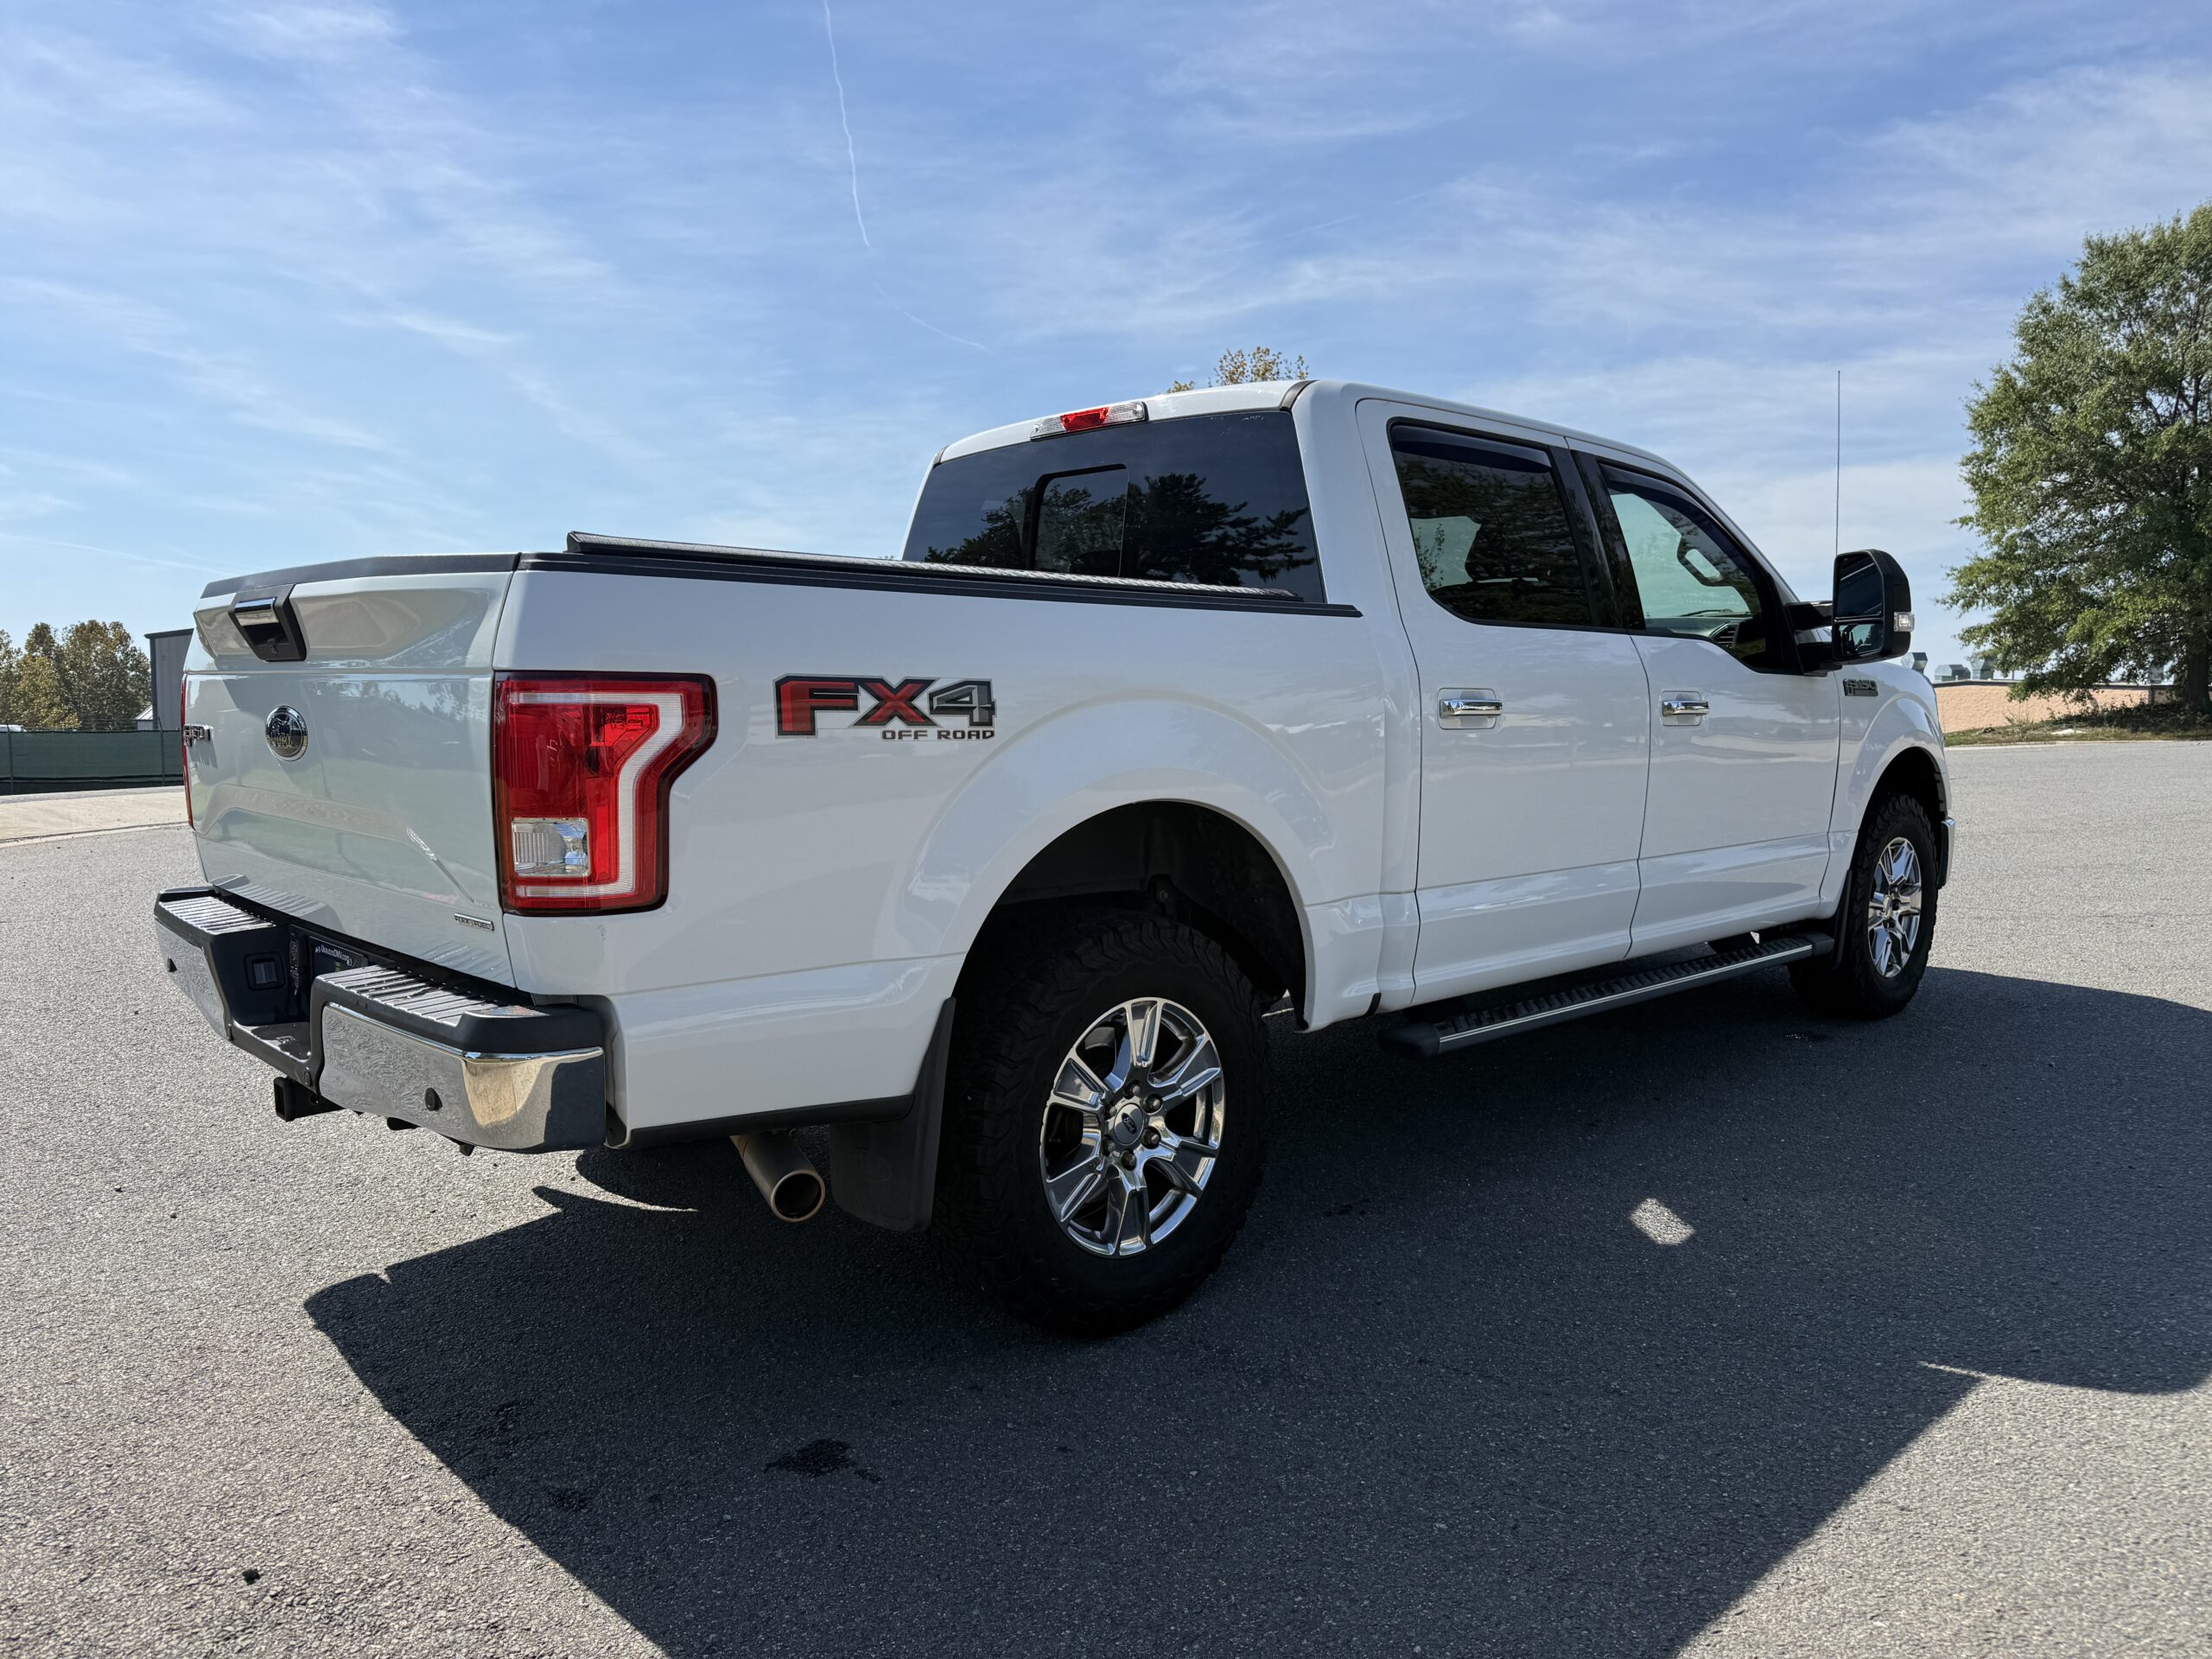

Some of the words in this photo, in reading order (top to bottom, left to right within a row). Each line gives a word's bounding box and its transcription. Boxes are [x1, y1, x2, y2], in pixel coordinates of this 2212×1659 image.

[775, 676, 996, 735] FX4
[882, 730, 928, 741] OFF
[937, 730, 995, 741] ROAD
